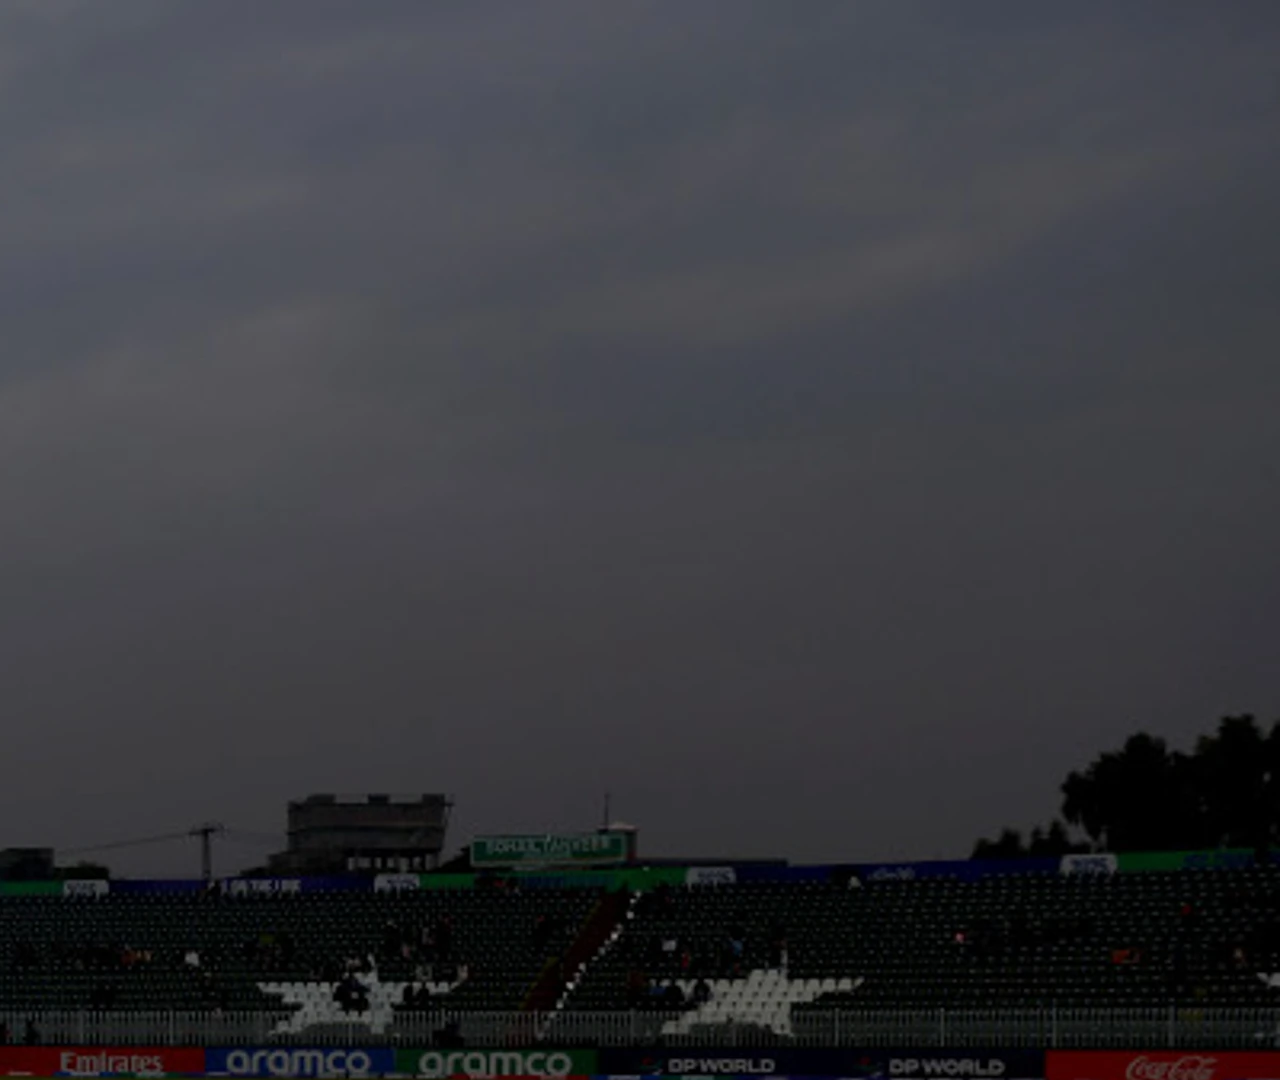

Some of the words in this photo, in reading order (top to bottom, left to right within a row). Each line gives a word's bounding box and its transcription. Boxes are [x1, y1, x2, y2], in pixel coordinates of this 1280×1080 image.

[60, 1052, 164, 1073] Emirates
[226, 1050, 372, 1075] aramco
[419, 1052, 572, 1076] aramco
[668, 1059, 700, 1074] DP
[702, 1059, 775, 1074] WORLD
[889, 1059, 920, 1076] DP
[922, 1059, 1005, 1076] WORLD
